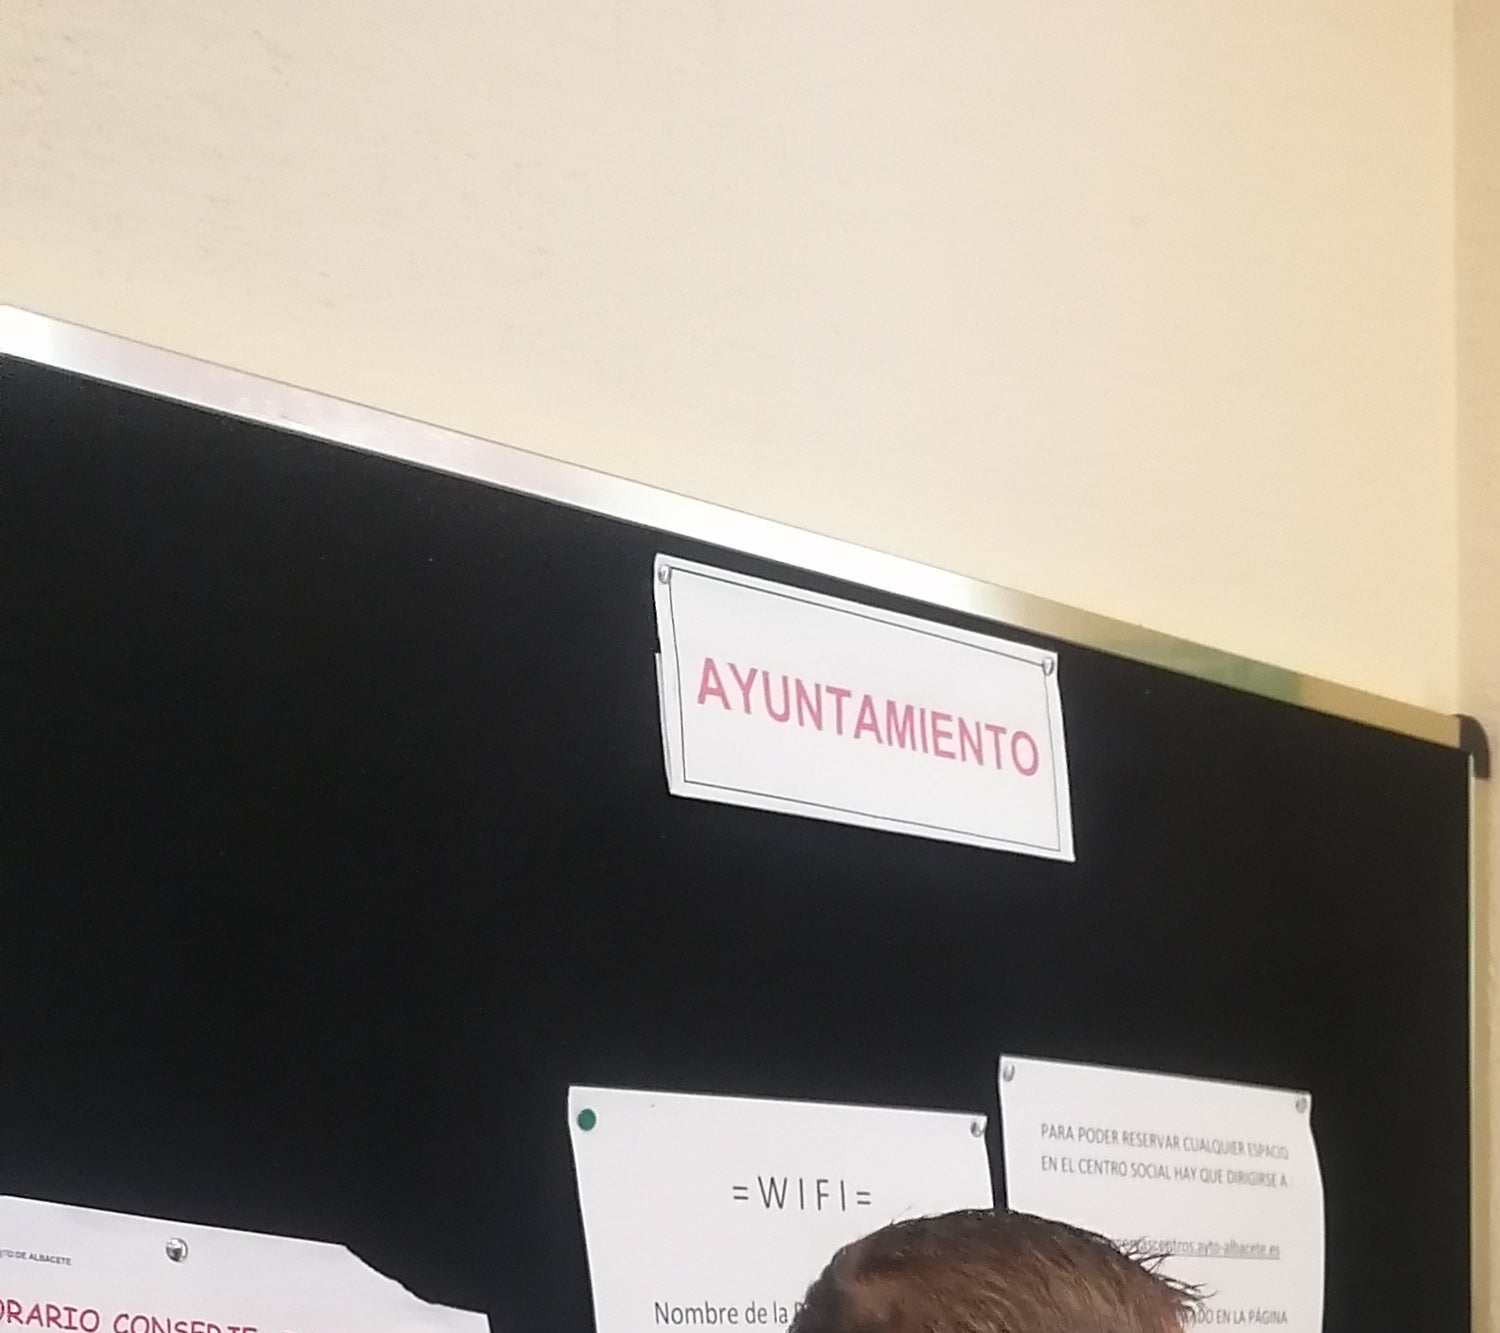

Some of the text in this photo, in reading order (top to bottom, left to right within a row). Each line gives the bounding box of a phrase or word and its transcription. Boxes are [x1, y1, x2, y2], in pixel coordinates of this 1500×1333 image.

[697, 656, 1040, 777] AYUNTAMIENTO
[1041, 1123, 1289, 1160] PARA PODER RESERVAR CUALQUIER ESPACIO
[1041, 1155, 1288, 1188] EN EL CENTRO SOCIAL HAY QUE DIRIGIRSE A
[29, 1253, 72, 1265] ALBACETE
[654, 1301, 738, 1325] Nombre
[745, 1301, 767, 1324] de
[773, 1301, 788, 1324] la
[1216, 1309, 1230, 1324] EN
[1233, 1309, 1246, 1324] LA
[1248, 1306, 1288, 1325] PÁGINA
